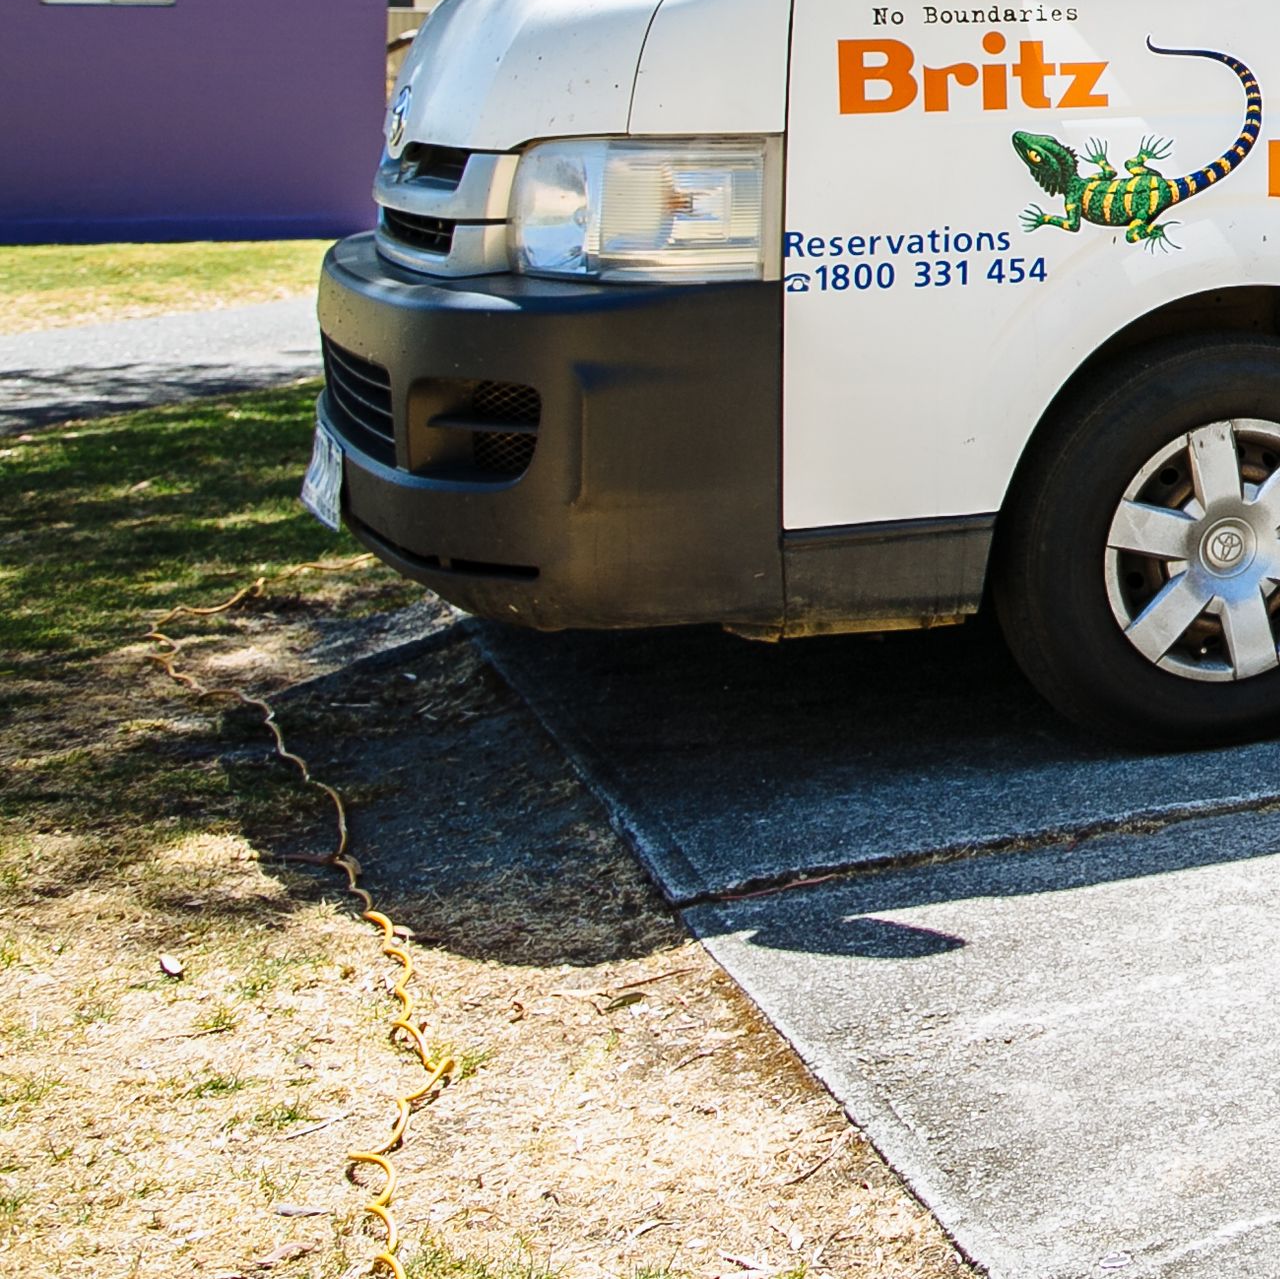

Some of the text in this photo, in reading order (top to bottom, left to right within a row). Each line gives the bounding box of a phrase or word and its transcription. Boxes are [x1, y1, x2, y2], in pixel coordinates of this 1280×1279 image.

[873, 4, 1078, 26] No Boundaries
[838, 31, 1109, 115] Britz
[784, 226, 1011, 258] Reservations
[815, 257, 1048, 291] 1800 331 454
